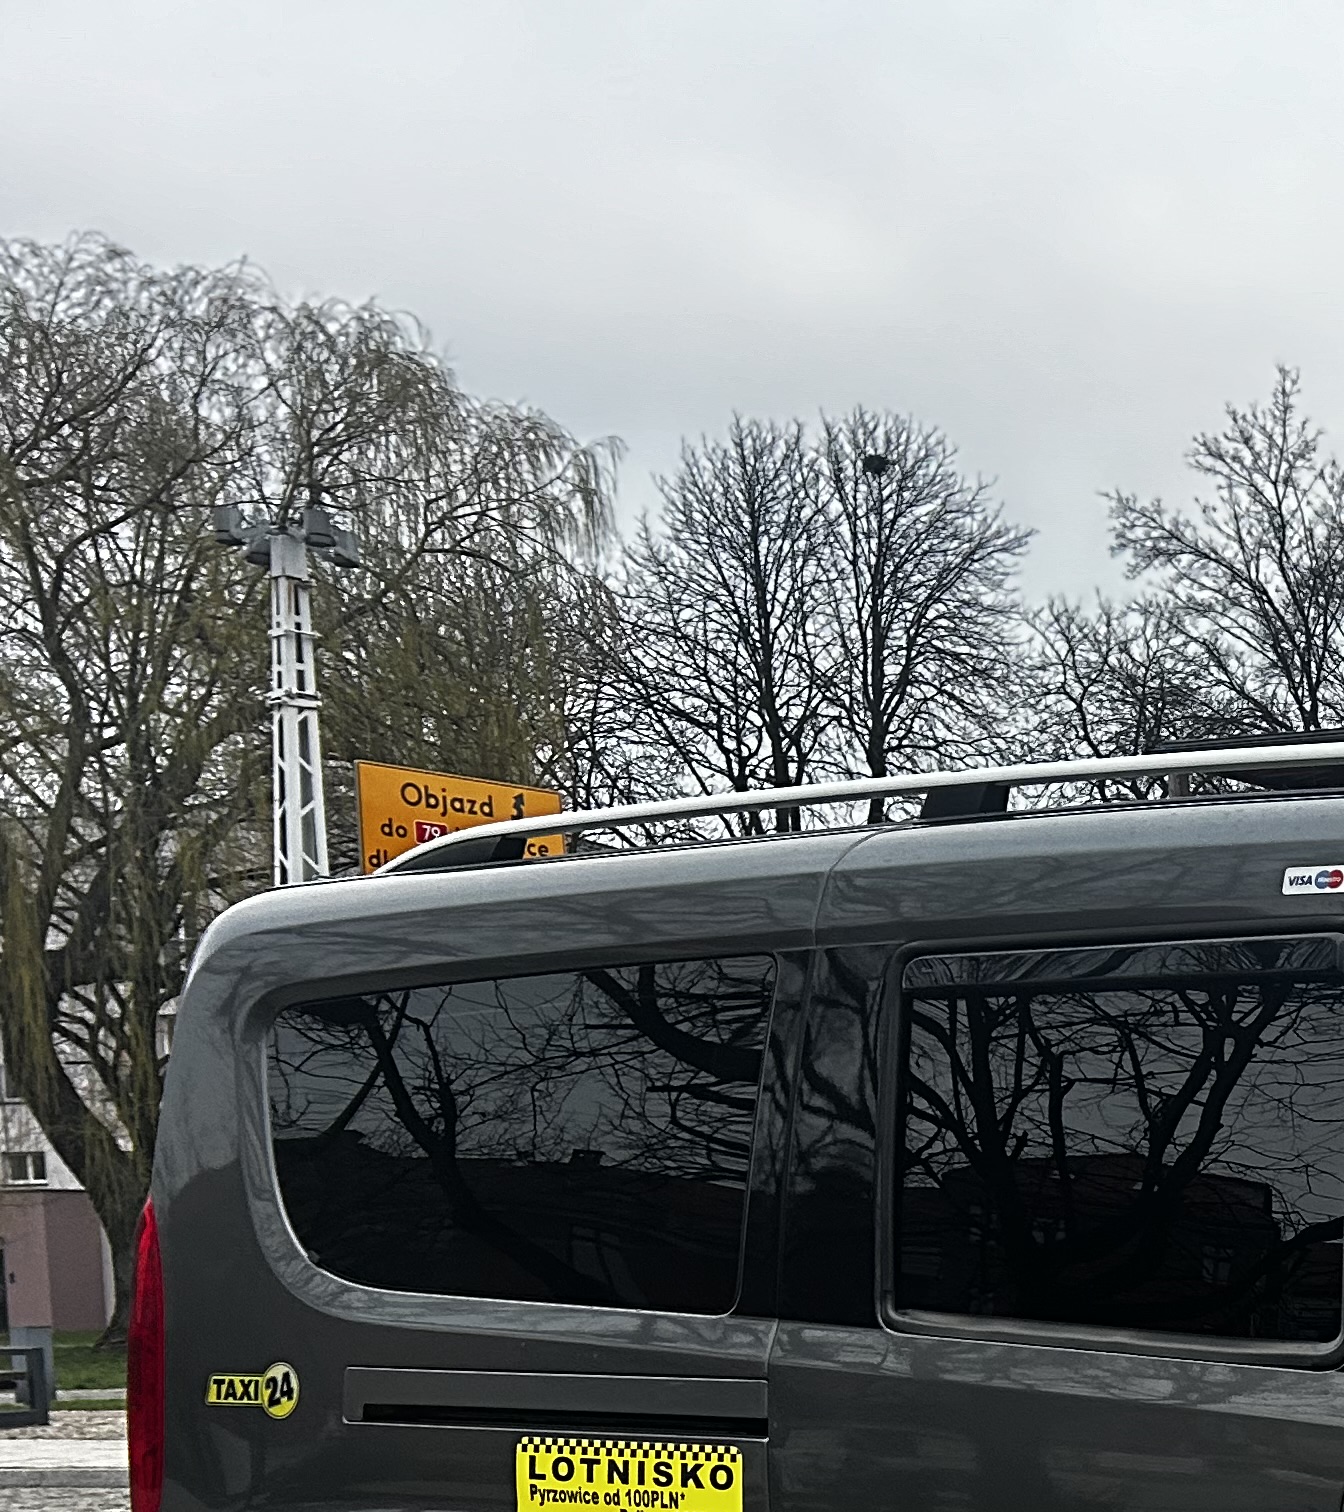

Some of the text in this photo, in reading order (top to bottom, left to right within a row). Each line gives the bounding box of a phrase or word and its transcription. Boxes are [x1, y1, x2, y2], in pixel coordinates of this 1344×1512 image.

[400, 781, 494, 817] Objazd
[380, 817, 441, 841] do 79
[368, 848, 394, 868] dl
[1288, 875, 1313, 887] VISA
[213, 1370, 294, 1408] TAXI 24
[528, 1454, 734, 1490] LOTNISKO
[529, 1484, 600, 1507] Pyrzowice
[603, 1488, 621, 1507] od
